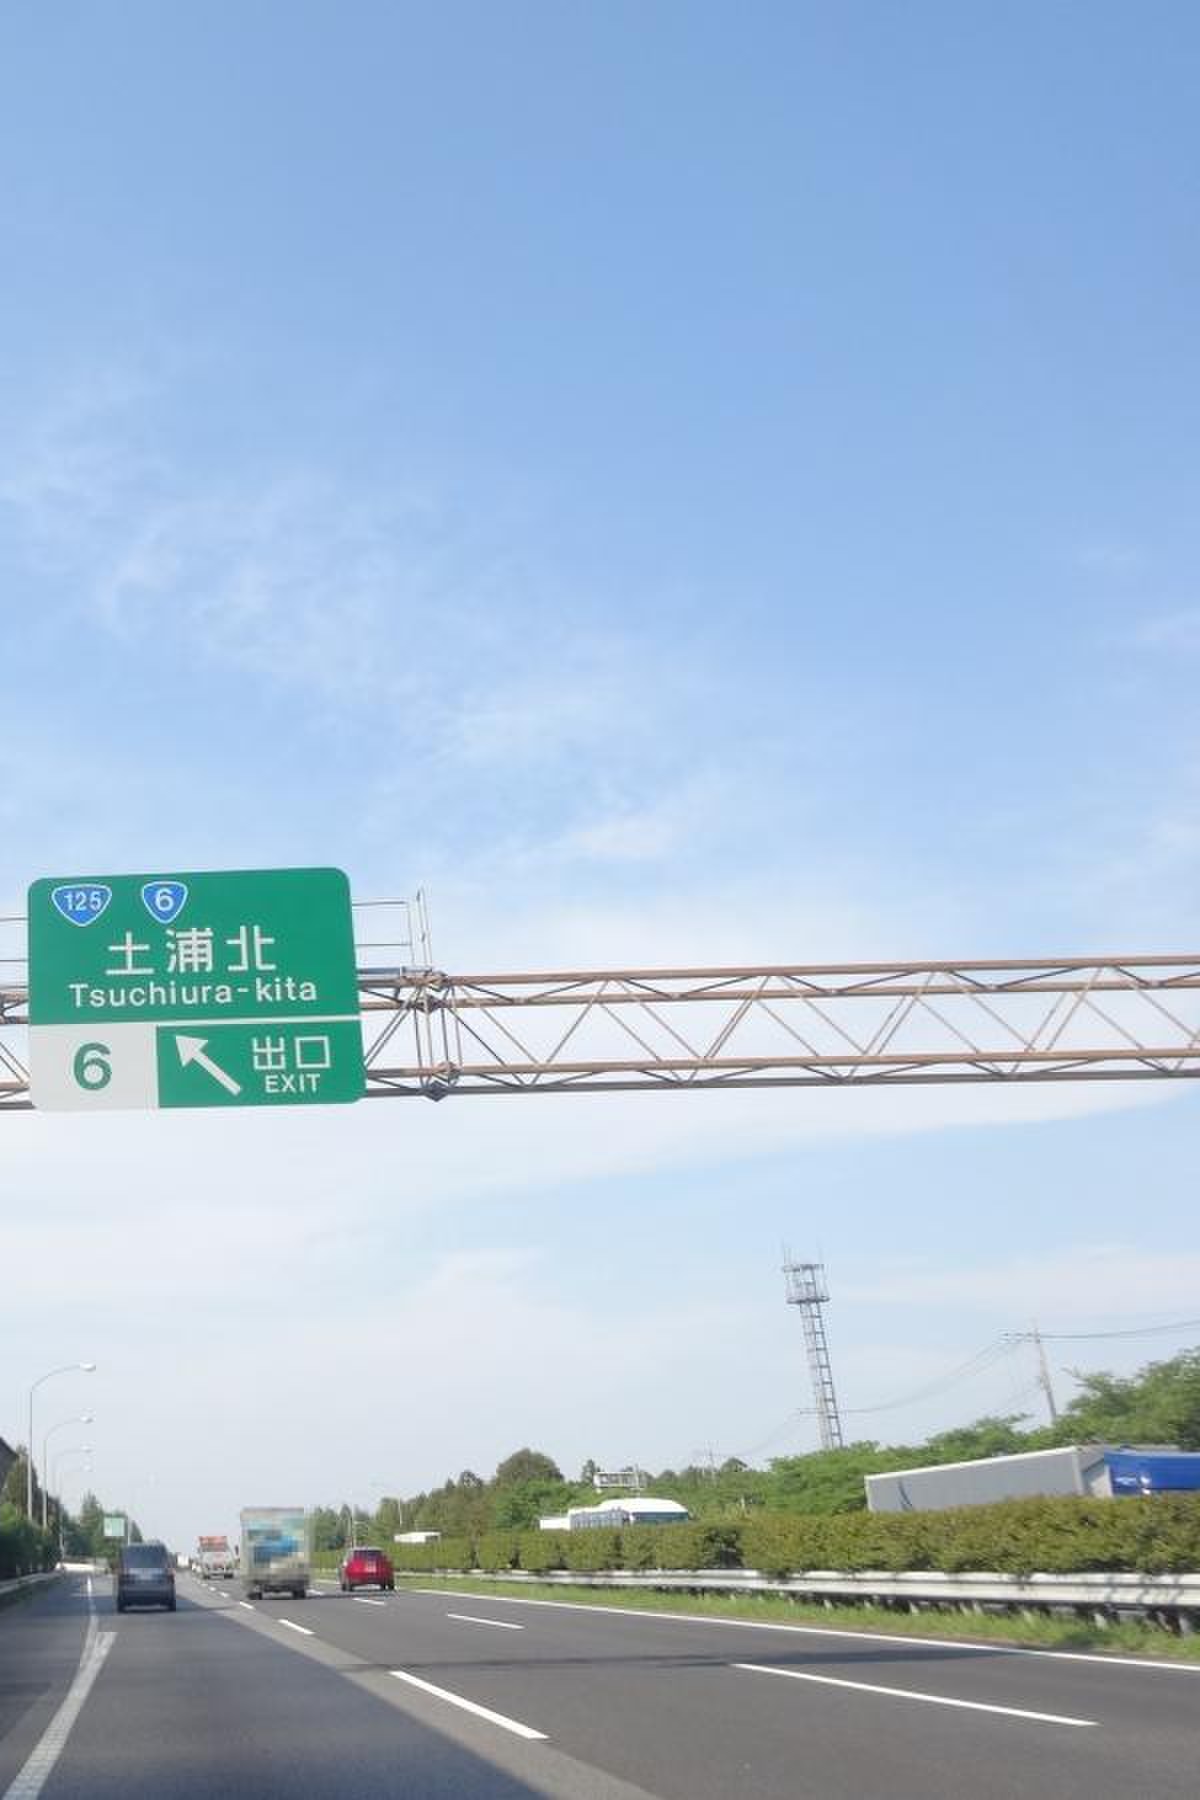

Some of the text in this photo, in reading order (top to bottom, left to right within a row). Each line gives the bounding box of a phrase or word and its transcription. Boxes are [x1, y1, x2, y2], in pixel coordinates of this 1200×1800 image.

[63, 892, 101, 912] 125
[154, 888, 173, 912] 6
[105, 925, 277, 976] 土浦北
[69, 978, 318, 1007] Tsuchiura-kita
[73, 1043, 112, 1091] 6
[252, 1036, 331, 1070] 出口
[265, 1074, 321, 1093] EXIT
